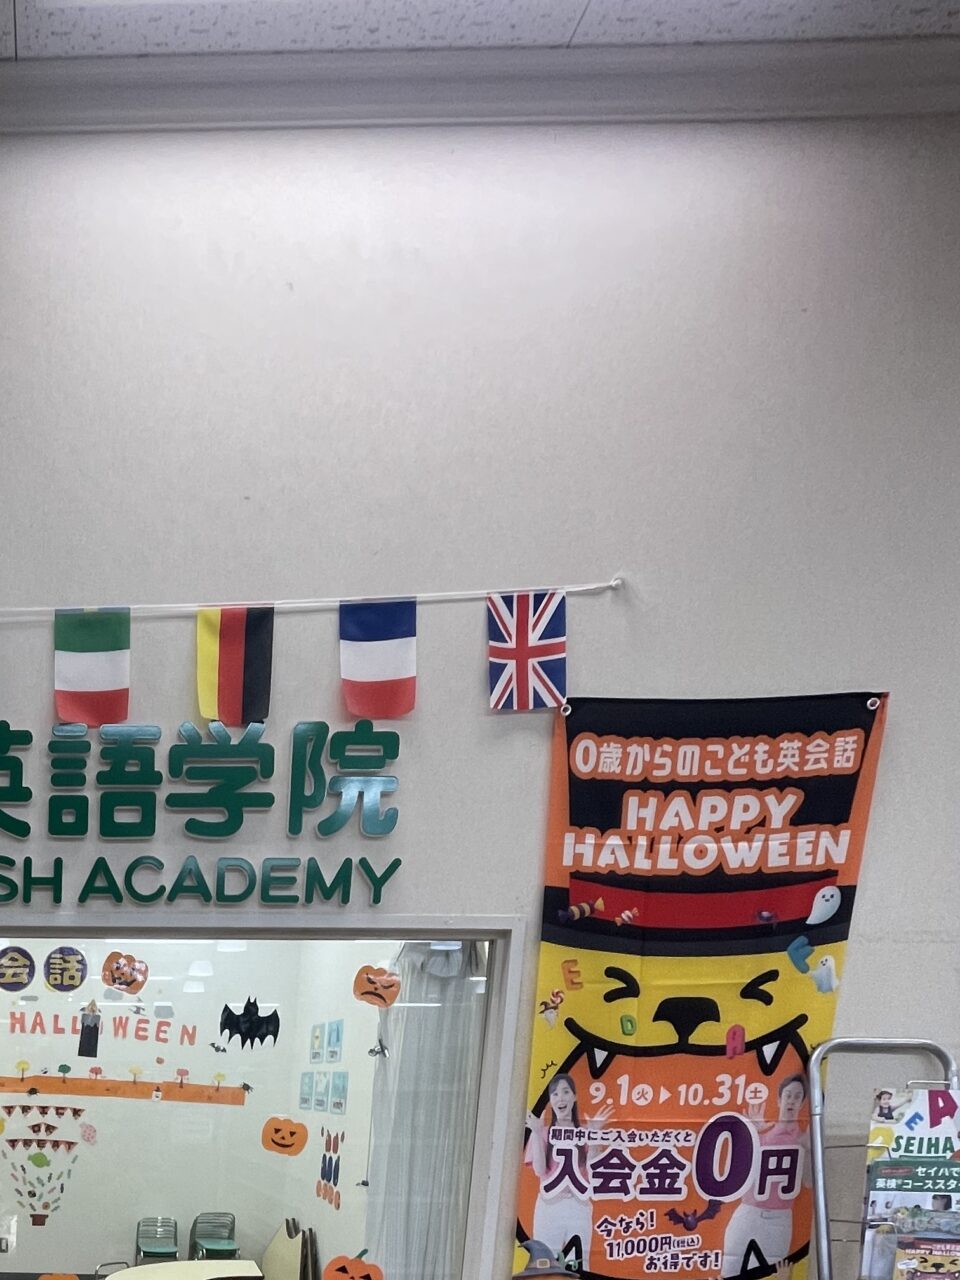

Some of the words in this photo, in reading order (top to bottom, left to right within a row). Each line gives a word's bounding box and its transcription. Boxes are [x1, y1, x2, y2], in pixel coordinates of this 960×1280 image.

[574, 734, 859, 777] 0歳からのこども英会話
[626, 793, 798, 832] HAPPY
[562, 829, 851, 870] HALLOWEEN
[78, 855, 402, 905] ACADEMY
[8, 1010, 198, 1046] HALLWEEN
[550, 1127, 694, 1144] 期間中にご入会いただくと
[892, 1135, 955, 1155] SEIHA
[596, 1210, 656, 1238] 今なら!
[644, 1251, 720, 1272] お得です!
